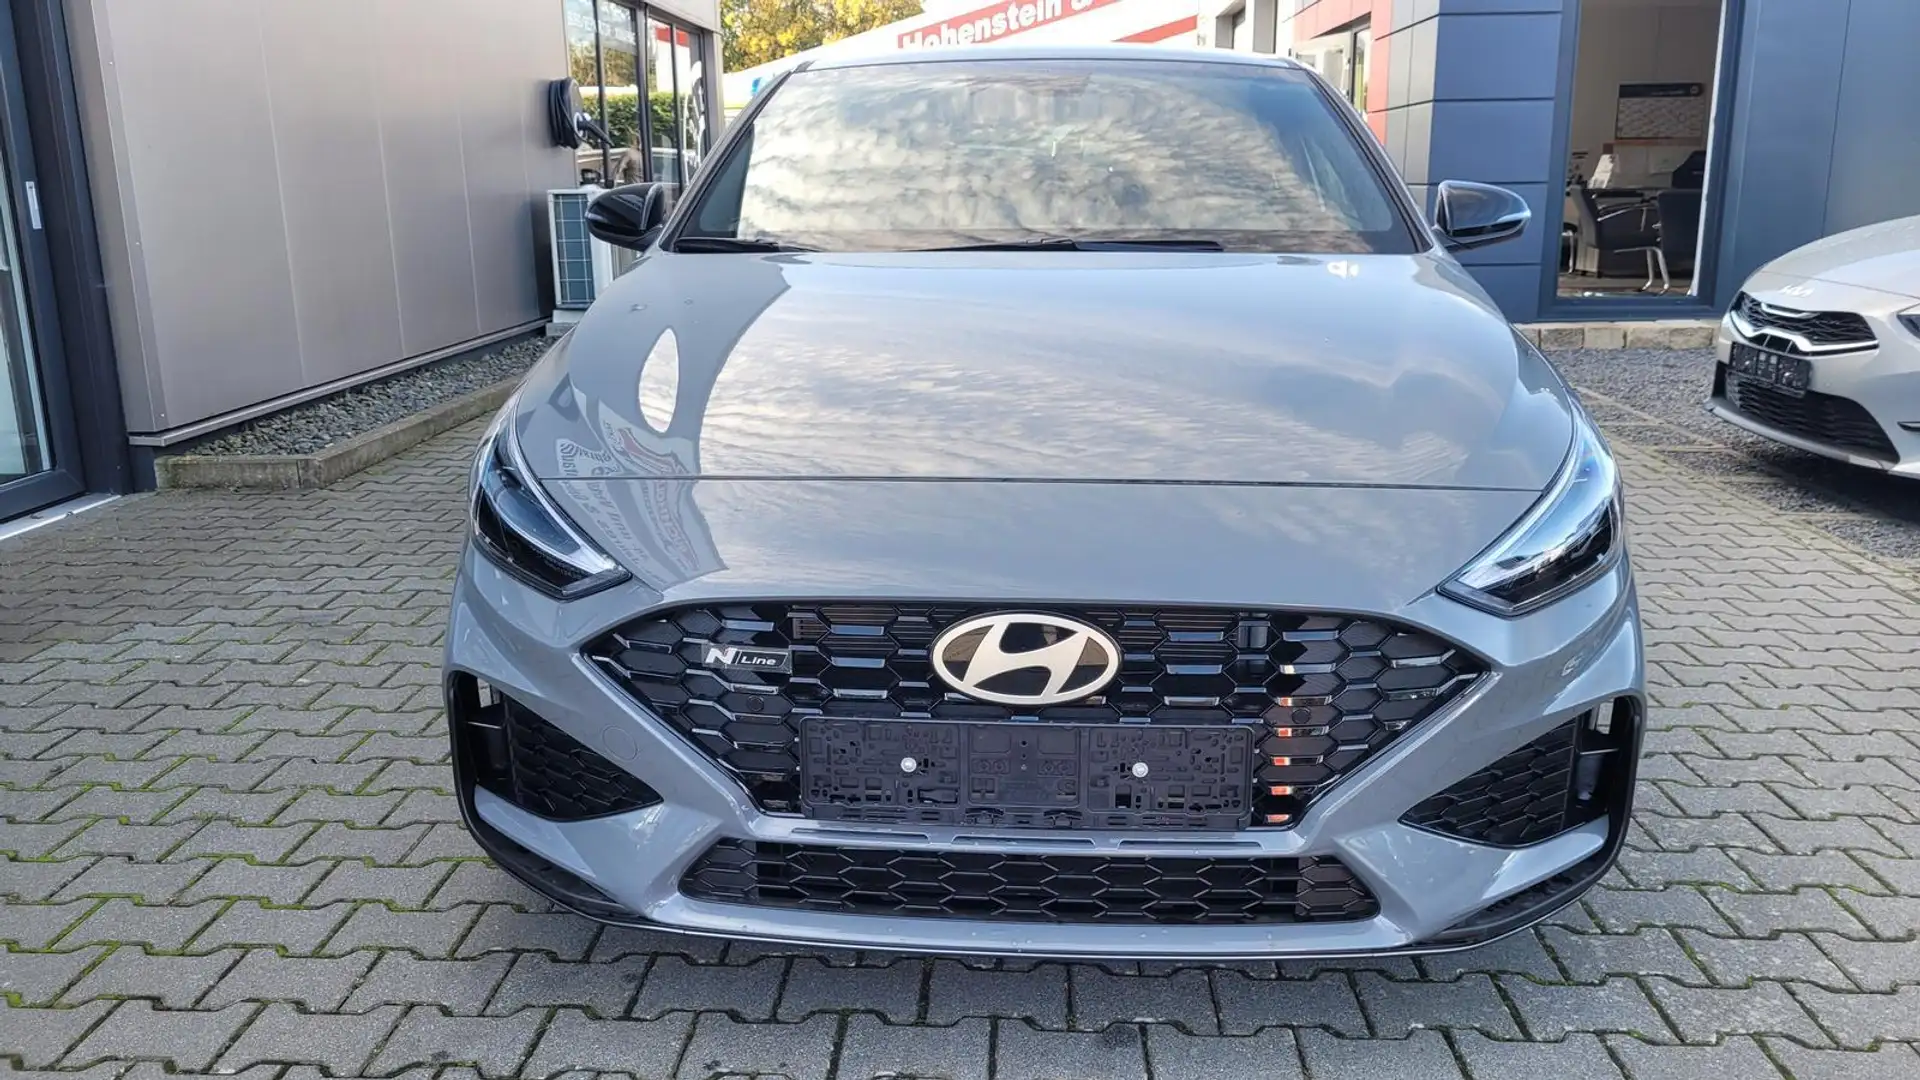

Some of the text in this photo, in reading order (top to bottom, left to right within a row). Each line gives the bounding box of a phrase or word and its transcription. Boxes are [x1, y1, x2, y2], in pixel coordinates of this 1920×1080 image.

[902, 0, 1062, 48] Hohenstein
[705, 646, 777, 666] N Line
